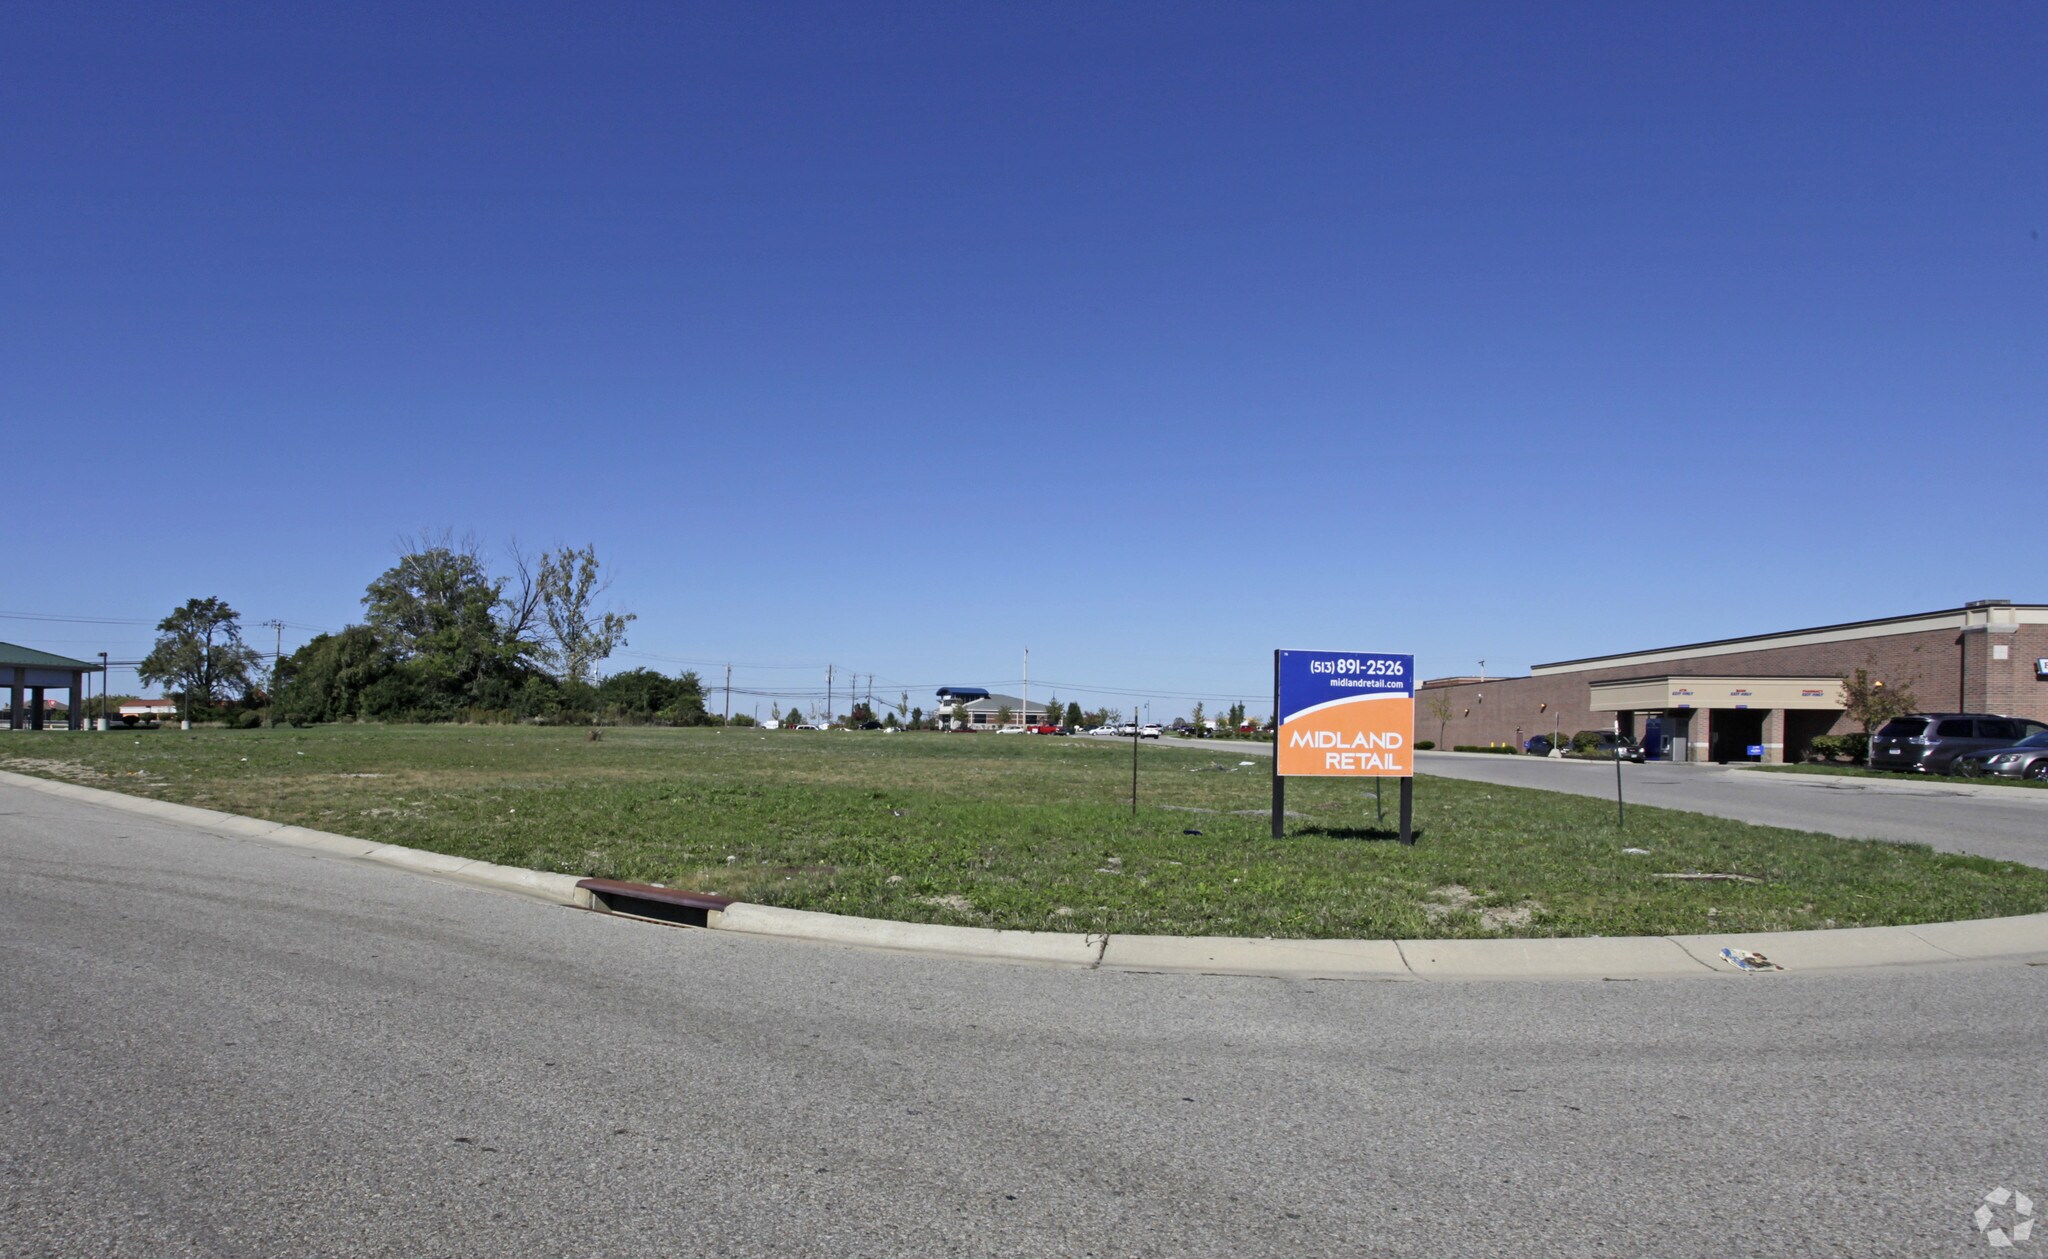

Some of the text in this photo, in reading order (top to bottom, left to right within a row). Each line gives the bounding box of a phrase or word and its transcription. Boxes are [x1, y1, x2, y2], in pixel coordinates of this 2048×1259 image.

[1310, 659, 1403, 675] (513) 891-2526
[1330, 678, 1403, 688] midlandretail.com
[1289, 730, 1403, 749] MIDLAND
[1325, 752, 1402, 770] RETAIL
